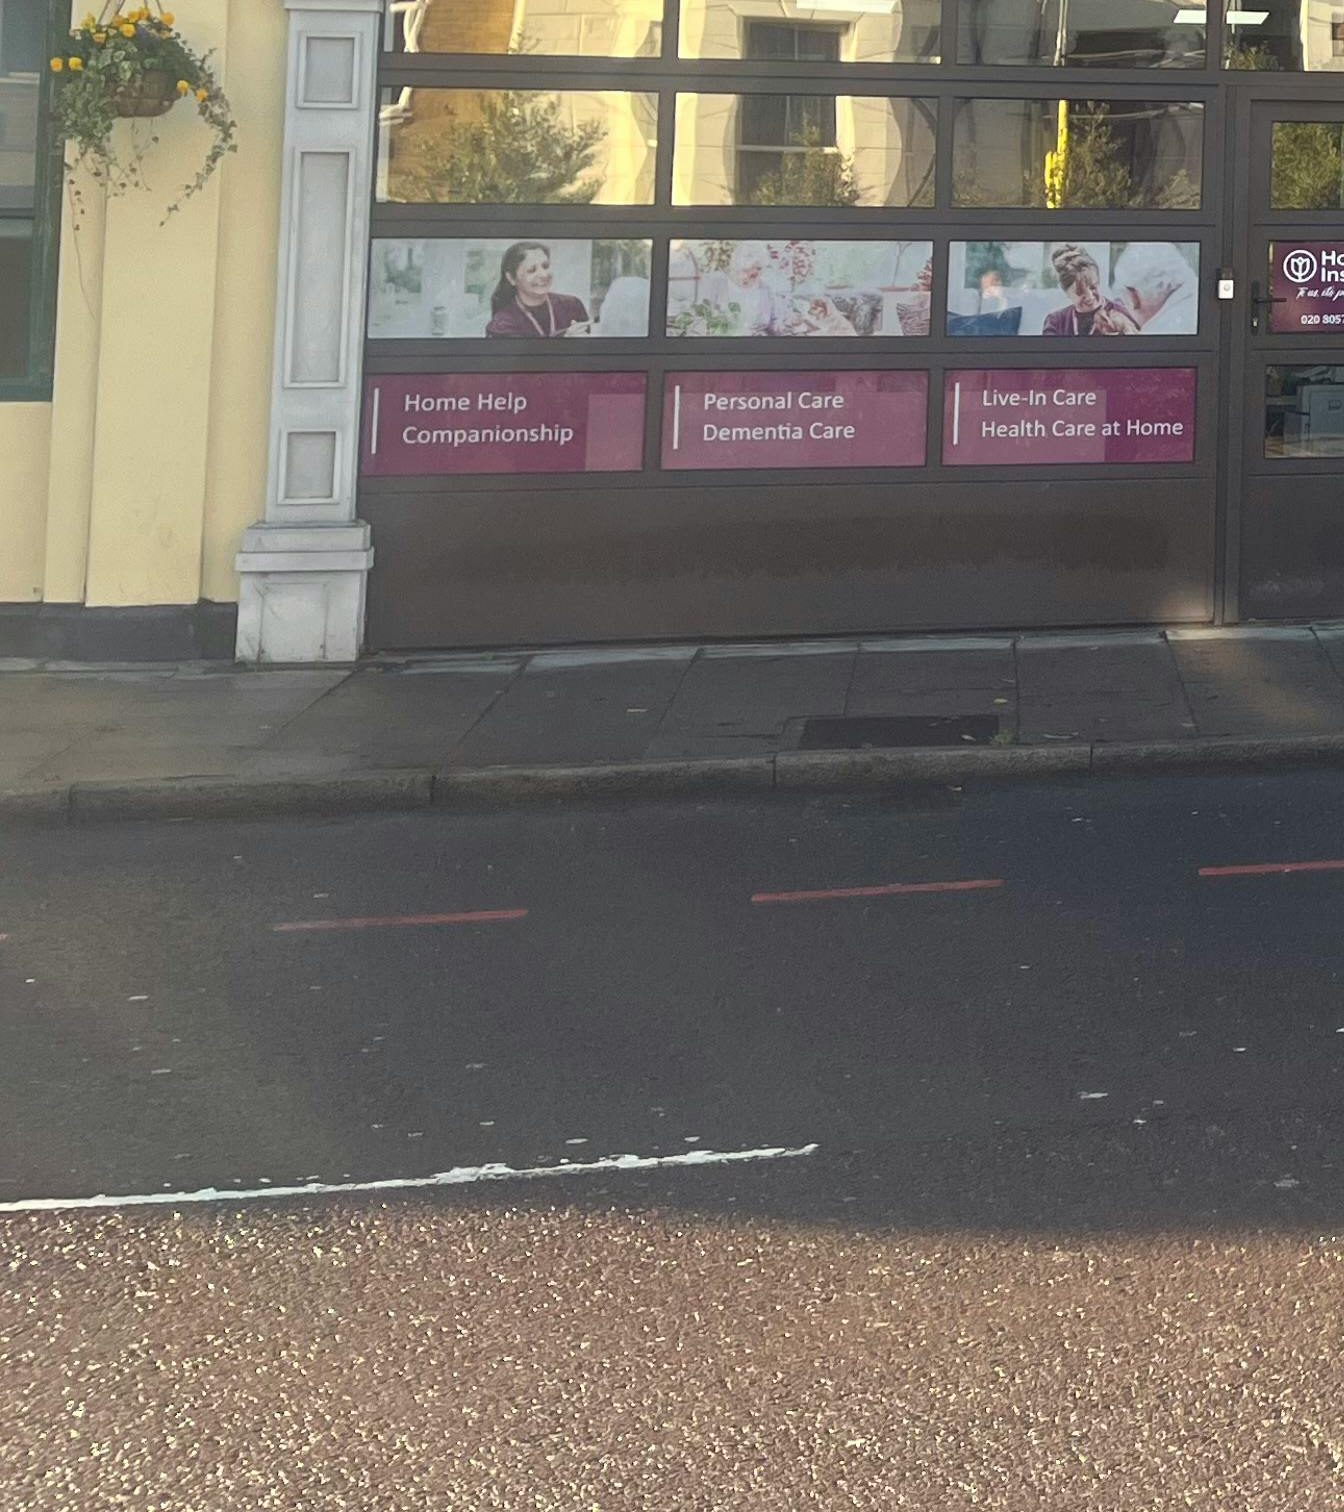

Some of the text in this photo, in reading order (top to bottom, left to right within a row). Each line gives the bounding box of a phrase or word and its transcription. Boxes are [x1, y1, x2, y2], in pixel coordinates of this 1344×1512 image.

[1301, 314, 1320, 325] 020
[403, 392, 528, 414] Home Help
[703, 392, 845, 411] Personal Care
[982, 388, 1097, 407] Live-In Care
[402, 424, 575, 447] Companionship
[703, 422, 856, 442] Dementia Care
[981, 419, 1184, 439] Health Care at Home
